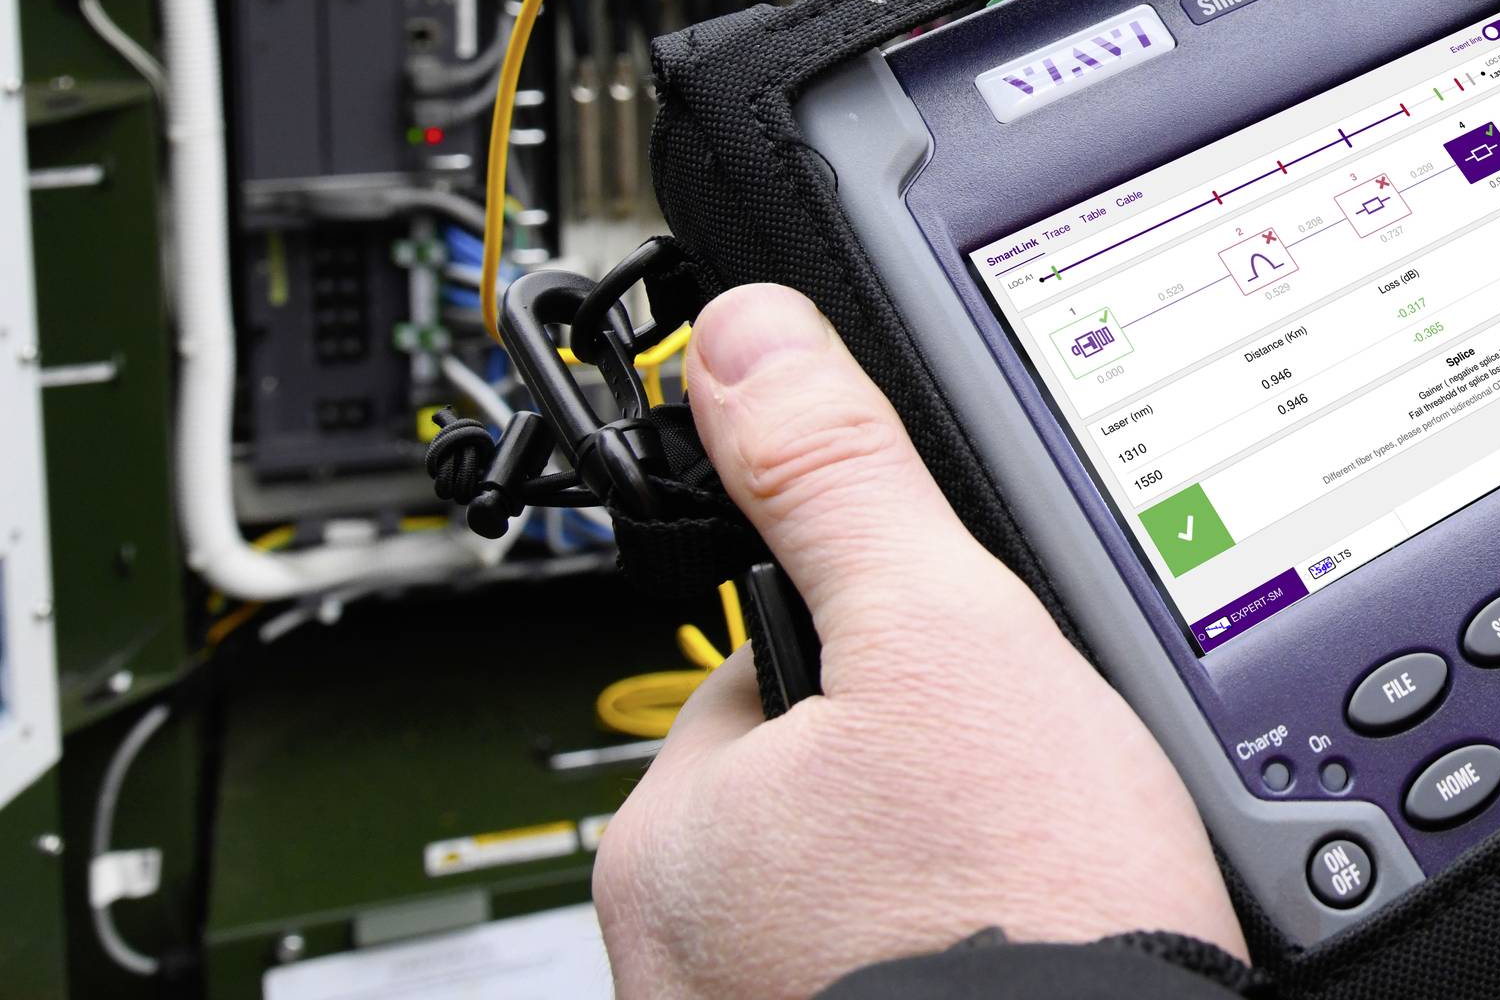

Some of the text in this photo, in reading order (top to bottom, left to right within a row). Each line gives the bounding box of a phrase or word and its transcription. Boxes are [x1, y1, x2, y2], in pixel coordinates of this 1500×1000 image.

[1449, 36, 1483, 54] Event line
[1002, 21, 1151, 95] VIAVI
[1485, 57, 1499, 67] LOC
[1350, 173, 1358, 182] 3
[1410, 162, 1434, 179] 0.209
[1116, 191, 1143, 207] Cable
[1079, 208, 1107, 223] Table
[1298, 216, 1324, 233] 0.208
[1042, 224, 1071, 240] Trace
[1235, 227, 1244, 237] 2
[1380, 225, 1404, 243] 0.737
[986, 238, 1039, 267] SmartLink
[1007, 273, 1034, 290] LOC A1
[1264, 282, 1290, 300] 0.529
[1377, 269, 1420, 294] Loss (dB)
[1158, 283, 1184, 301] 0.529
[1069, 307, 1076, 315] 1
[1397, 297, 1426, 318] -0.317
[1414, 321, 1444, 342] -0.365
[1244, 326, 1308, 363] Distance (Km)
[1446, 348, 1475, 367] Splice
[1097, 365, 1125, 384] 0.000
[1261, 368, 1292, 390] 0.946
[1418, 383, 1444, 400] Gainer
[1448, 364, 1479, 384] negative
[1479, 353, 1500, 368] splice
[1277, 393, 1308, 415] 0.946
[1408, 407, 1424, 420] Fail
[1423, 388, 1458, 412] threshold
[1456, 384, 1468, 394] for
[1468, 373, 1490, 388] splice
[1101, 404, 1153, 436] Laser (nm)
[1322, 462, 1356, 485] Different
[1355, 453, 1373, 466] fiber
[1373, 442, 1398, 458] types,
[1396, 427, 1422, 445] please
[1421, 411, 1451, 432] perform
[1449, 386, 1493, 414] bidirectional
[1118, 443, 1147, 463] 1310
[1134, 470, 1163, 490] 1550
[1333, 549, 1352, 564] LTS
[1230, 587, 1284, 623] EXPERT-SM
[1382, 672, 1417, 704] FILE
[1236, 724, 1288, 760] Charge
[1308, 733, 1332, 754] On
[1435, 762, 1480, 801] HOME
[1323, 845, 1350, 874] ON
[1332, 863, 1361, 896] OFF
